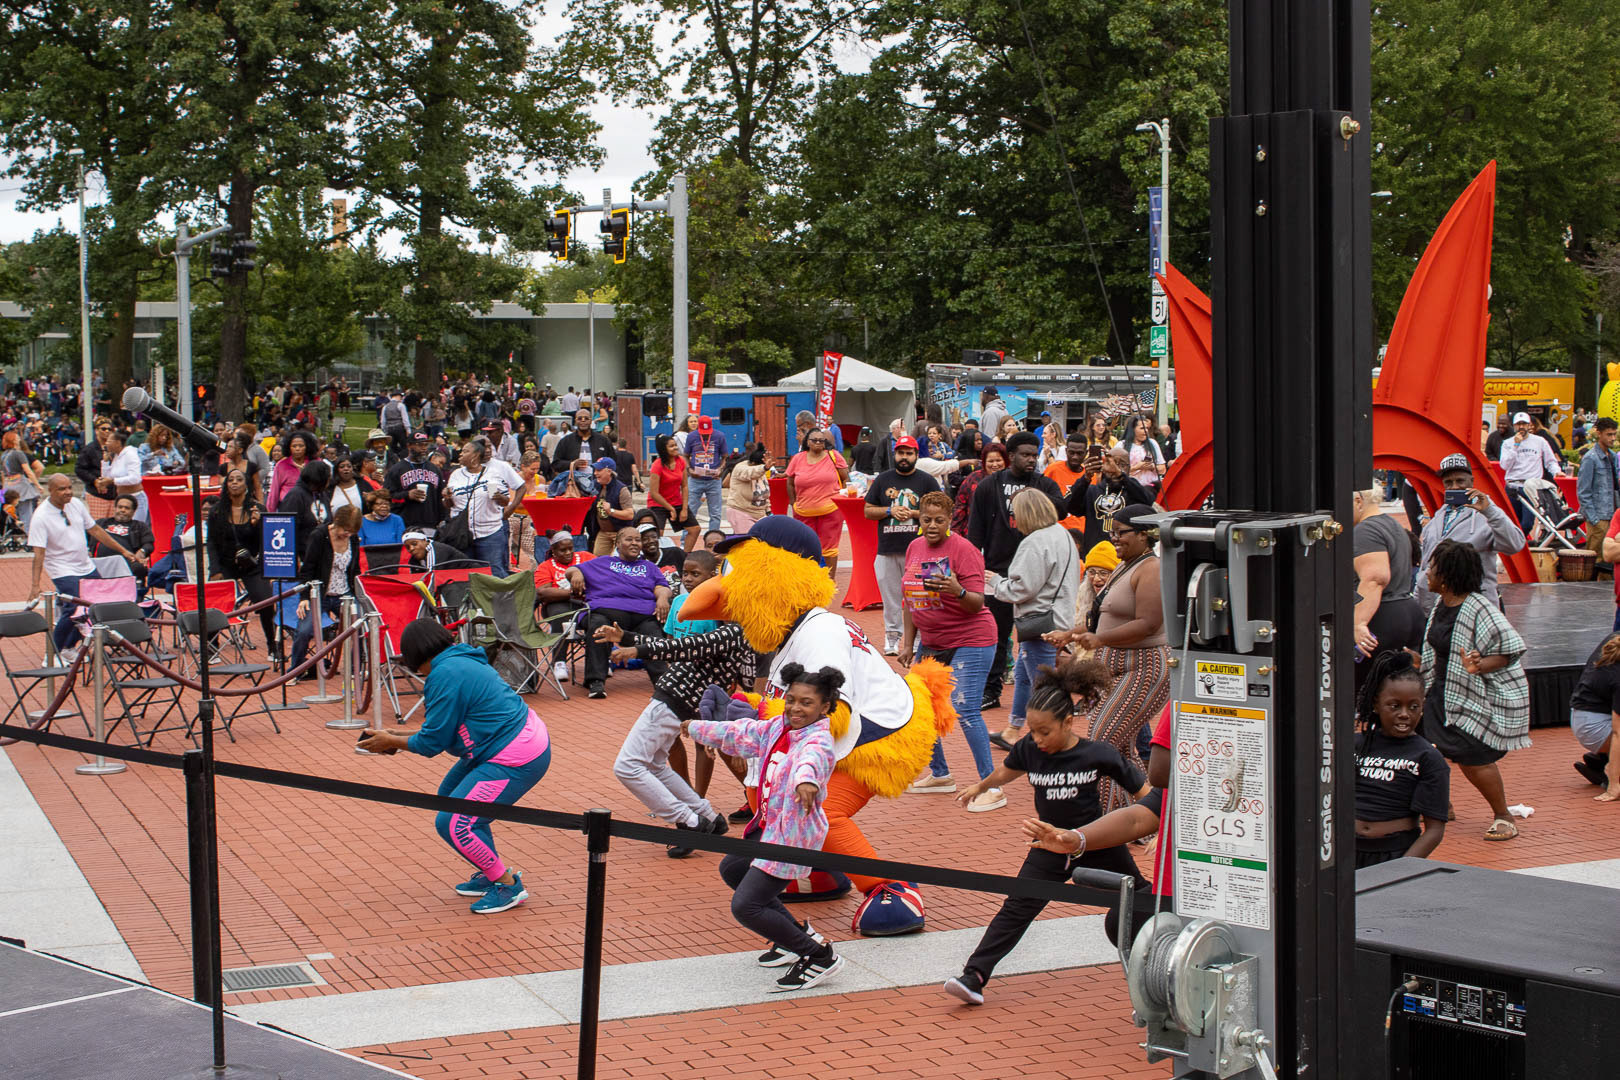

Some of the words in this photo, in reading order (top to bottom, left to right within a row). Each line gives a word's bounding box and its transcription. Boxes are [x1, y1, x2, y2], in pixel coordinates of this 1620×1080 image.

[1155, 301, 1164, 318] 51
[820, 373, 835, 412] FIRST
[1484, 381, 1539, 396] CHICKEN
[1209, 664, 1240, 675] CAUTION
[1319, 624, 1332, 701] Tower
[1209, 706, 1238, 717] WARNING
[1320, 707, 1334, 784] Super
[1360, 767, 1395, 781] STUDIO
[1384, 758, 1420, 776] DANCE
[1067, 769, 1098, 786] DANCE
[1046, 786, 1079, 801] STUDIO
[1203, 815, 1246, 838] GLS
[1320, 793, 1332, 862] Genie
[1210, 855, 1234, 866] NOTICE
